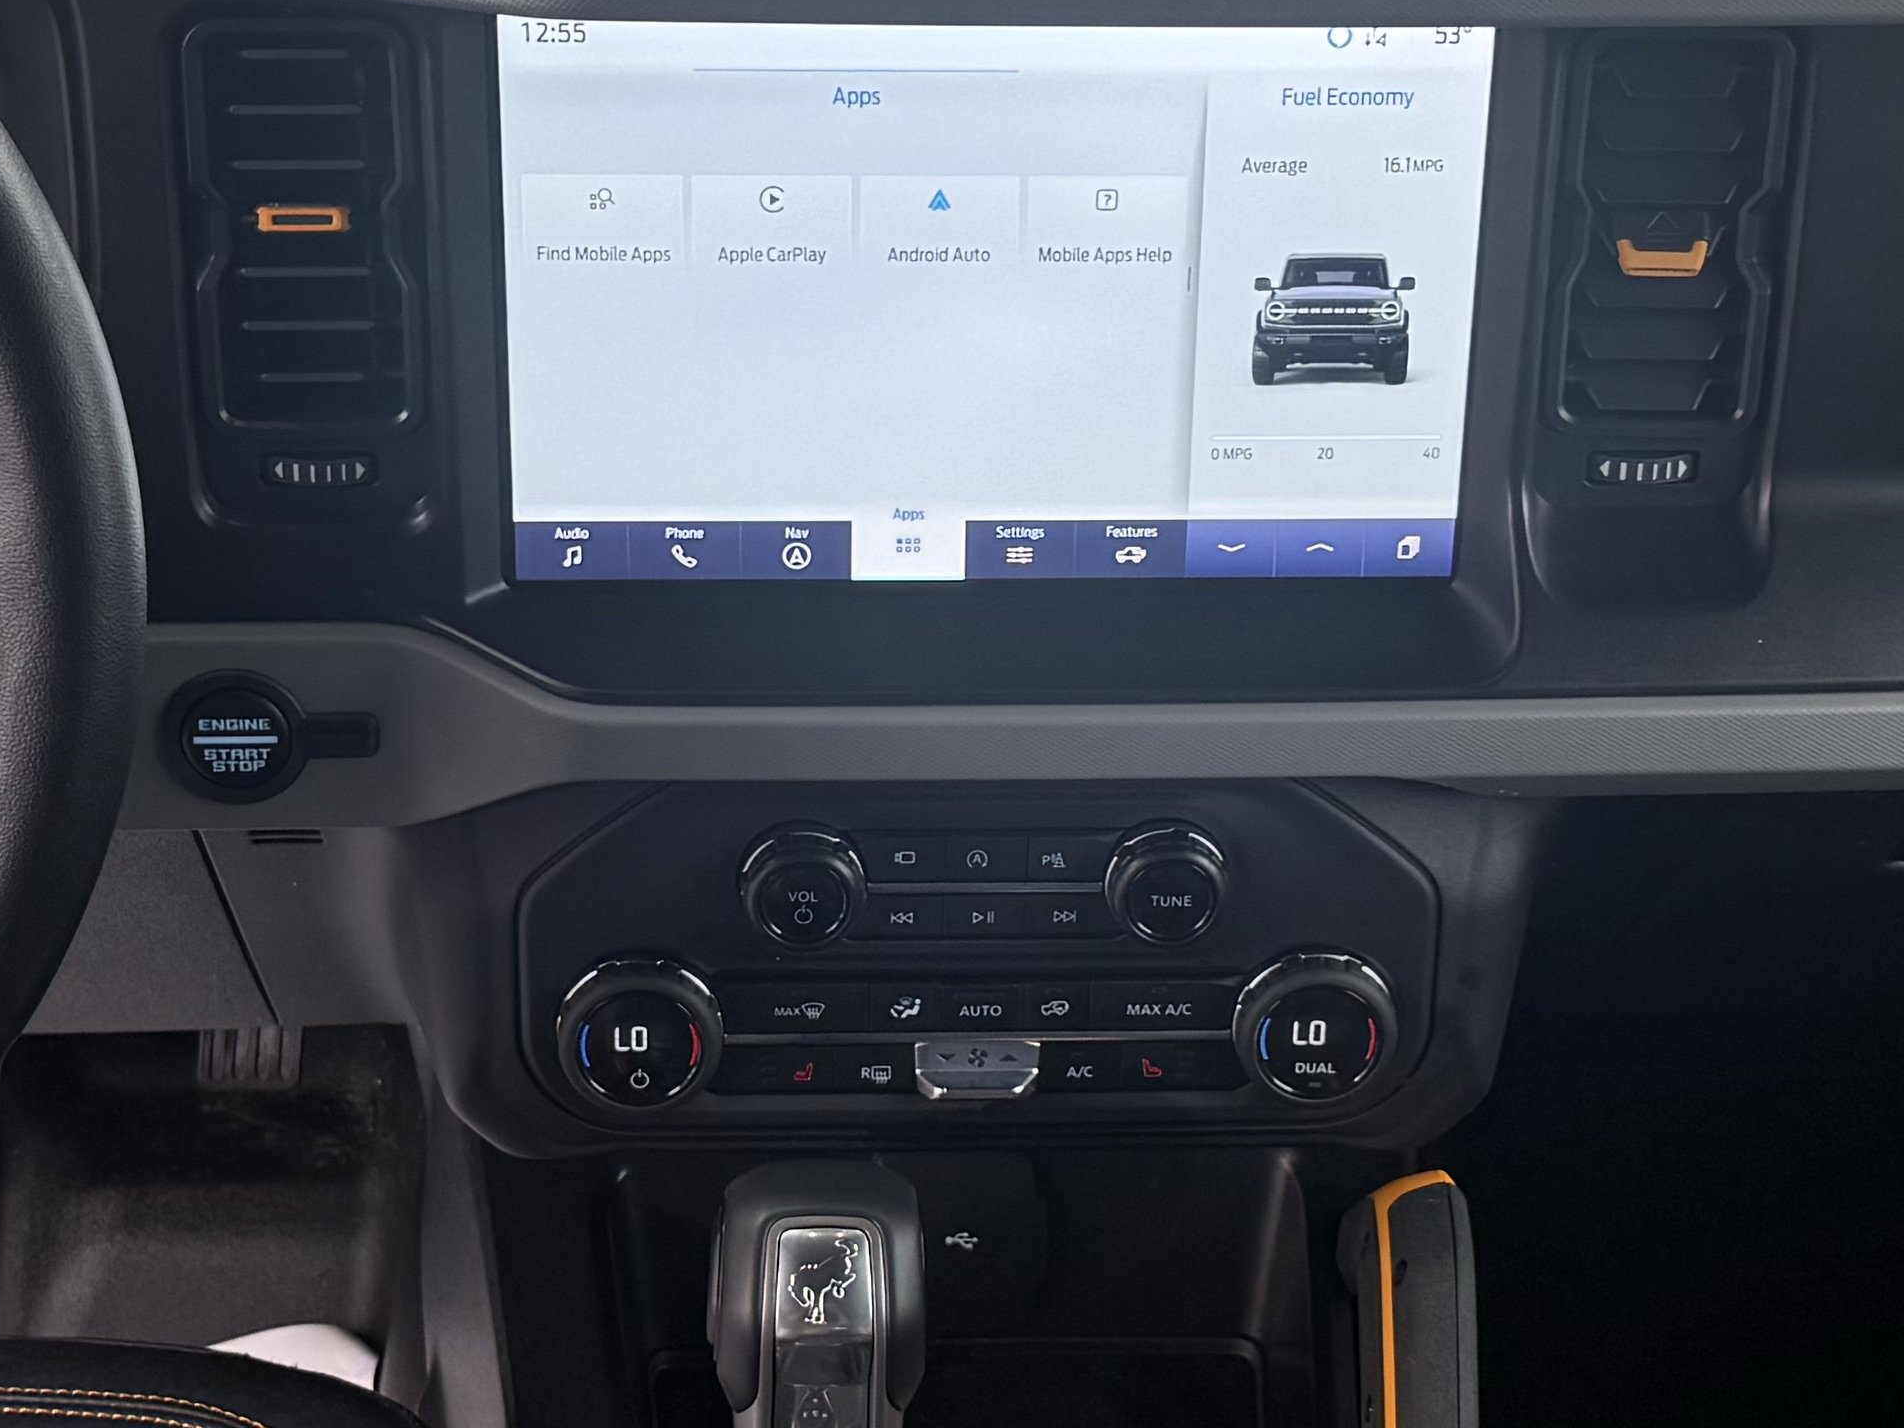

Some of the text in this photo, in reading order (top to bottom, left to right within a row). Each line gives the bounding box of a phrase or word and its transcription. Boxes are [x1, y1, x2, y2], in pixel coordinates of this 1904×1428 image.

[520, 22, 587, 44] 12:55
[832, 86, 881, 109] Apps
[1281, 87, 1414, 109] Fuel Economy
[1241, 157, 1308, 176] Average
[536, 245, 672, 265] Find Mobile Apps
[717, 245, 826, 265] Apple CarPlay
[887, 245, 990, 263] Android Auto
[1037, 245, 1172, 265] Mobile Apps Help
[1211, 447, 1253, 461] 0 MPG
[1317, 447, 1334, 461] 20
[1422, 447, 1440, 460] 40
[892, 508, 925, 522] Apps
[554, 526, 589, 540] Audio
[665, 526, 704, 540] Phone
[784, 526, 809, 540] Nav
[995, 526, 1044, 541] Settings
[1106, 526, 1158, 539] Features
[198, 718, 271, 731] ENGINE
[204, 748, 271, 761] START
[212, 760, 266, 772] STOP
[788, 892, 818, 902] VOL
[1151, 895, 1192, 907] TUNE
[775, 1007, 801, 1016] MAX
[959, 1004, 1002, 1016] AUTO
[1127, 1003, 1192, 1016] MAX A/C
[614, 1026, 648, 1051] LO
[1292, 1020, 1326, 1046] LO
[1067, 1066, 1093, 1078] A/C
[1295, 1062, 1336, 1074] DUAL
